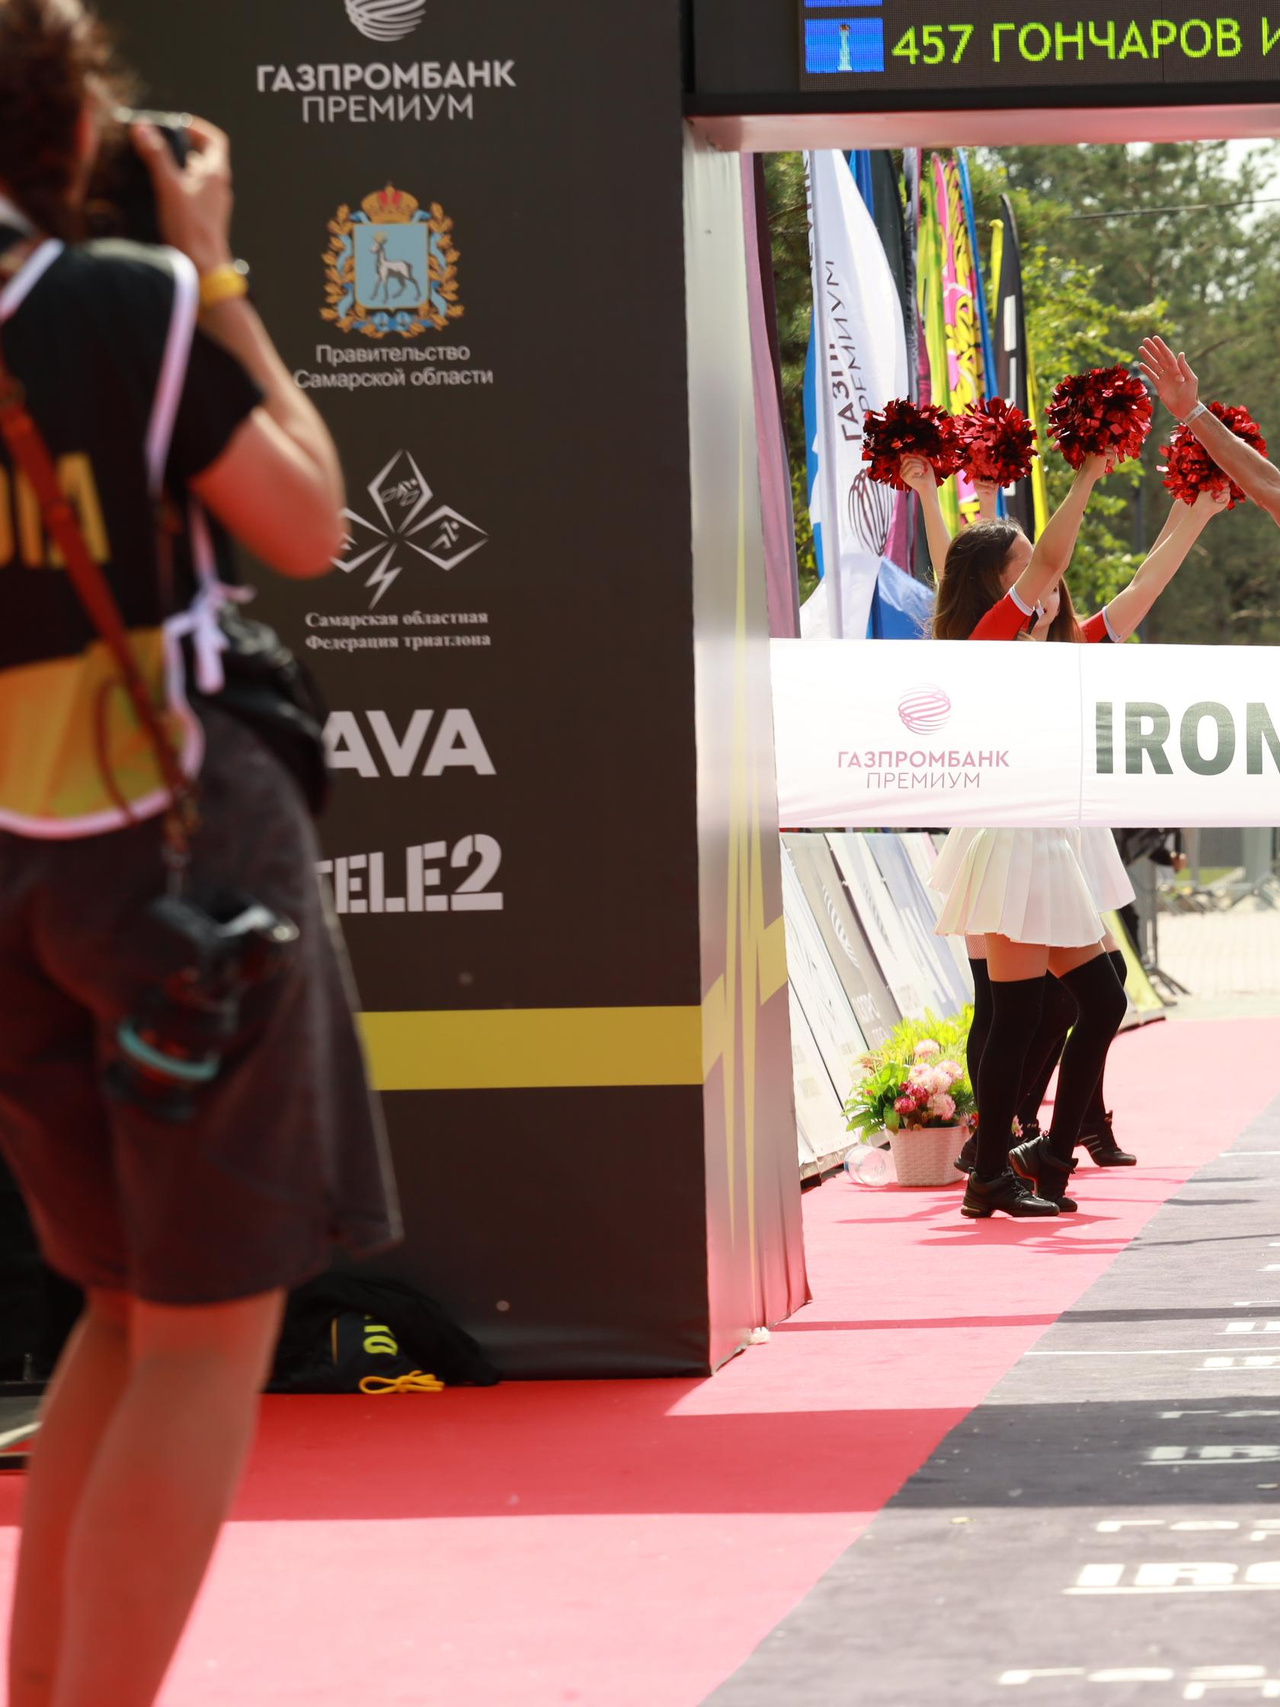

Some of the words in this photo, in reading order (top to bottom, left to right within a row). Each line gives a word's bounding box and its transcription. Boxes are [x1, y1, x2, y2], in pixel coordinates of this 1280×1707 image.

[890, 23, 975, 65] 457
[990, 17, 1243, 63] ГОНЧАРОВ
[256, 60, 516, 92] ГАЗПРОМБАНК
[302, 93, 474, 123] ПРЕМИУМ
[315, 344, 471, 367] Правительство
[293, 368, 405, 391] Самарской
[410, 367, 494, 386] области
[305, 612, 398, 630] Самарская
[402, 610, 488, 624] областная
[305, 634, 399, 652] Федерация
[404, 634, 491, 651] триатлона
[837, 750, 1010, 769] ГАЗПРОМБАНК
[866, 772, 981, 789] ПРЕМИУМ
